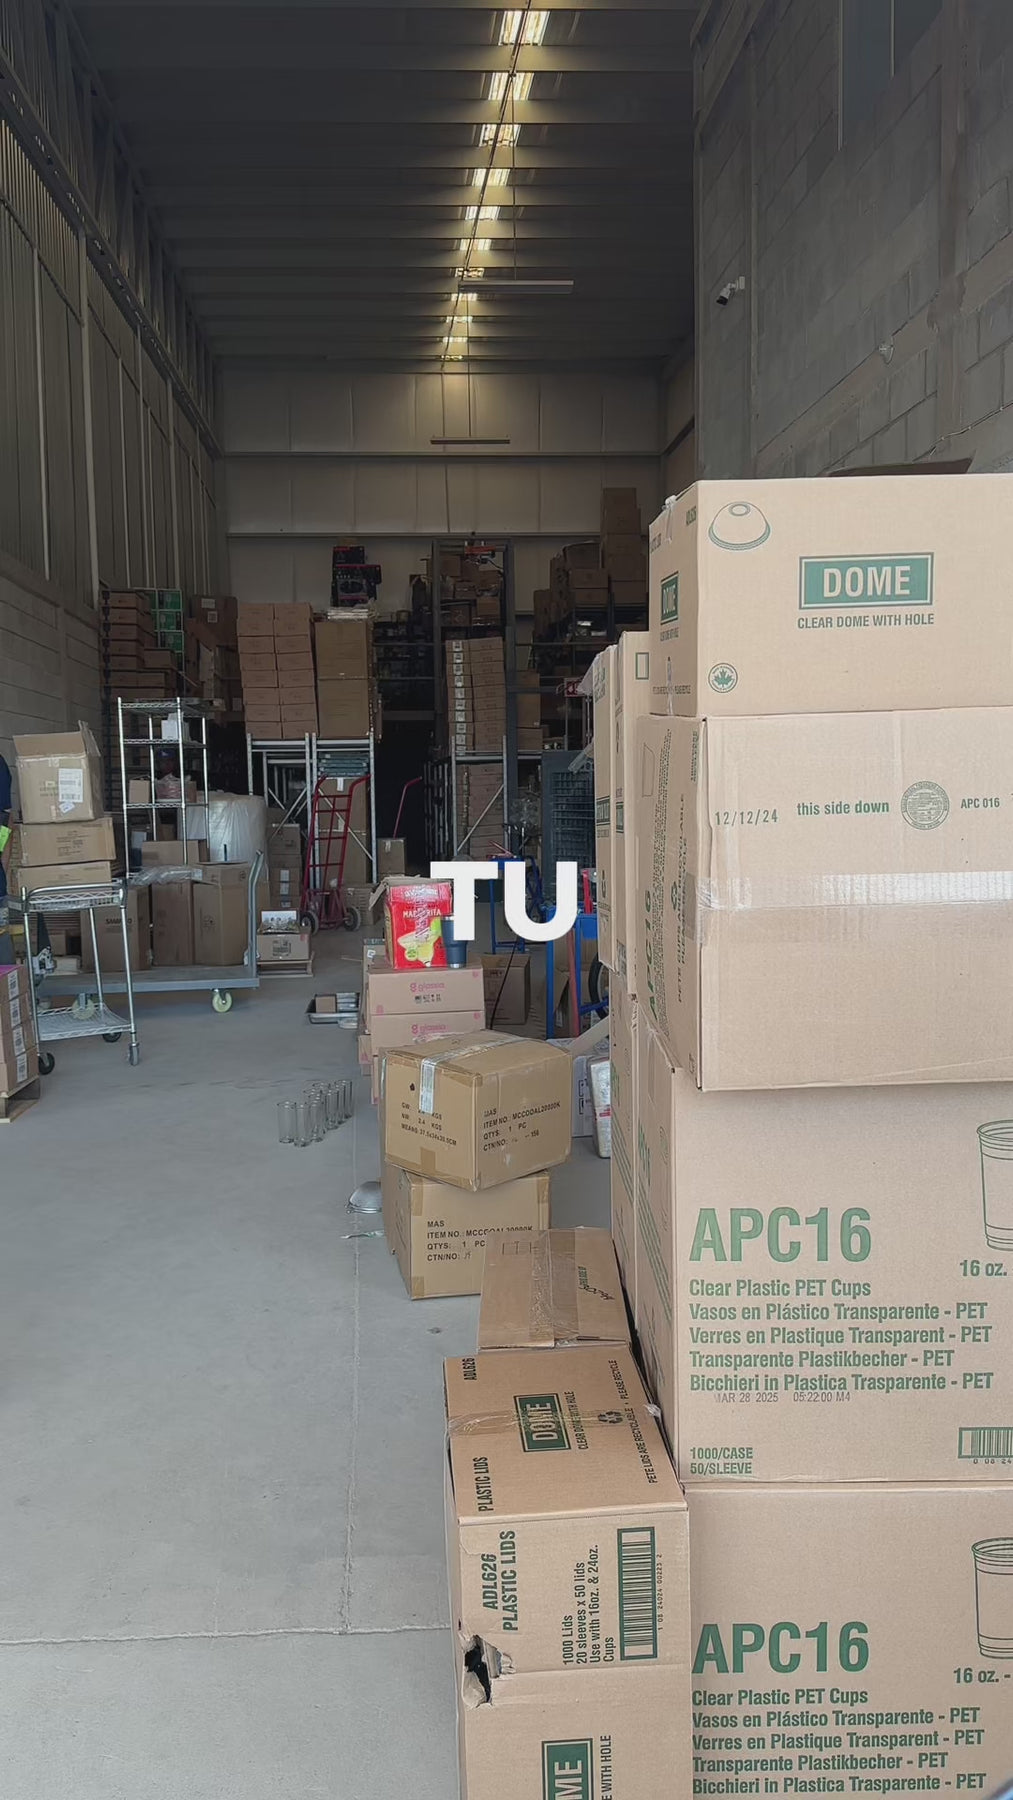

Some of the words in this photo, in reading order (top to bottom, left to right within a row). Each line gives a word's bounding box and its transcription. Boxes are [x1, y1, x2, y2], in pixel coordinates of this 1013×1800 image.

[824, 565, 910, 597] DOME
[798, 617, 832, 629] CLEAR
[837, 616, 869, 627] DOME
[873, 614, 901, 626] WITH
[905, 613, 934, 625] HOLE
[797, 802, 820, 816] this
[824, 801, 850, 815] side
[855, 799, 889, 814] down
[961, 798, 980, 809] APC
[983, 798, 1000, 808] 016
[715, 809, 778, 826] 12/12/24
[484, 1119, 497, 1129] ITEM
[689, 1207, 872, 1263] APC16
[428, 1253, 459, 1261] CTN/NO:
[960, 1260, 980, 1276] 16
[986, 1263, 1007, 1276] oz.
[689, 1280, 731, 1296] Clear
[736, 1279, 790, 1296] Plastic
[795, 1280, 826, 1296] PET
[831, 1279, 871, 1299] Cups
[689, 1304, 736, 1320] Vasos
[742, 1308, 760, 1320] en
[766, 1303, 829, 1320] Plástico
[834, 1303, 939, 1323] Transparente
[956, 1303, 987, 1319] PET
[690, 1327, 742, 1344] Verres
[747, 1331, 765, 1344] en
[771, 1327, 844, 1347] Plastique
[849, 1327, 944, 1346] Transparent
[961, 1326, 992, 1342] PET
[462, 1357, 477, 1380] ADL626
[690, 1351, 793, 1370] Transparente
[799, 1350, 907, 1367] Plastikbecher
[923, 1350, 954, 1366] PET
[608, 1360, 623, 1381] RECYCLE
[615, 1381, 629, 1400] PLEASE
[690, 1374, 759, 1390] Bicchieri
[764, 1375, 779, 1390] in
[784, 1374, 847, 1390] Plastica
[852, 1373, 946, 1393] Trasparente
[963, 1373, 993, 1389] PET
[564, 1391, 576, 1405] HOLE
[739, 1393, 751, 1403] 28
[756, 1392, 779, 1403] 2025
[526, 1402, 559, 1441] DOME
[624, 1407, 645, 1442] RECYCLABLE
[575, 1433, 589, 1450] CLEAR
[637, 1442, 648, 1454] ARE
[640, 1455, 653, 1468] LIDS
[690, 1448, 753, 1460] 1000/CASE
[472, 1456, 489, 1474] LIDS
[690, 1463, 751, 1474] 50/SLEEVE
[644, 1468, 658, 1483] PETE
[474, 1476, 494, 1512] PLASTIC
[500, 1530, 516, 1563] LIDS
[588, 1545, 598, 1574] 24oz.
[481, 1554, 498, 1610] ADL626
[574, 1562, 584, 1583] lids
[588, 1576, 598, 1584] &
[501, 1569, 518, 1631] PLASTIC
[575, 1587, 585, 1597] 50
[589, 1588, 599, 1615] 16oz.
[562, 1615, 572, 1636] Lids
[576, 1611, 586, 1648] sleeves
[589, 1616, 599, 1643] with
[563, 1641, 573, 1664] 1000
[577, 1651, 587, 1664] 20
[590, 1646, 600, 1663] Use
[603, 1637, 616, 1662] Cups
[691, 1622, 869, 1674] APC16
[954, 1667, 973, 1683] 16
[978, 1670, 999, 1683] oz.
[692, 1690, 733, 1706] Clear
[738, 1689, 790, 1705] Plastic
[795, 1688, 825, 1704] PET
[830, 1688, 868, 1706] Cups
[693, 1713, 738, 1728] Vasos
[743, 1715, 761, 1727] en
[767, 1711, 828, 1726] Plástico
[833, 1709, 933, 1726] Transparente
[950, 1707, 980, 1723] PET
[600, 1735, 612, 1762] HOLE
[693, 1735, 742, 1750] Verres
[747, 1737, 765, 1749] en
[771, 1733, 841, 1751] Plastique
[847, 1731, 938, 1749] Transparent
[954, 1730, 984, 1745] PET
[693, 1756, 792, 1775] Transparente
[798, 1753, 902, 1771] Plastikbecher
[918, 1752, 948, 1767] PET
[601, 1765, 612, 1792] WITH
[693, 1778, 759, 1794] Bicchieri
[765, 1778, 778, 1793] in
[784, 1777, 844, 1792] Plastica
[849, 1775, 940, 1794] Trasparente
[956, 1773, 986, 1789] PET
